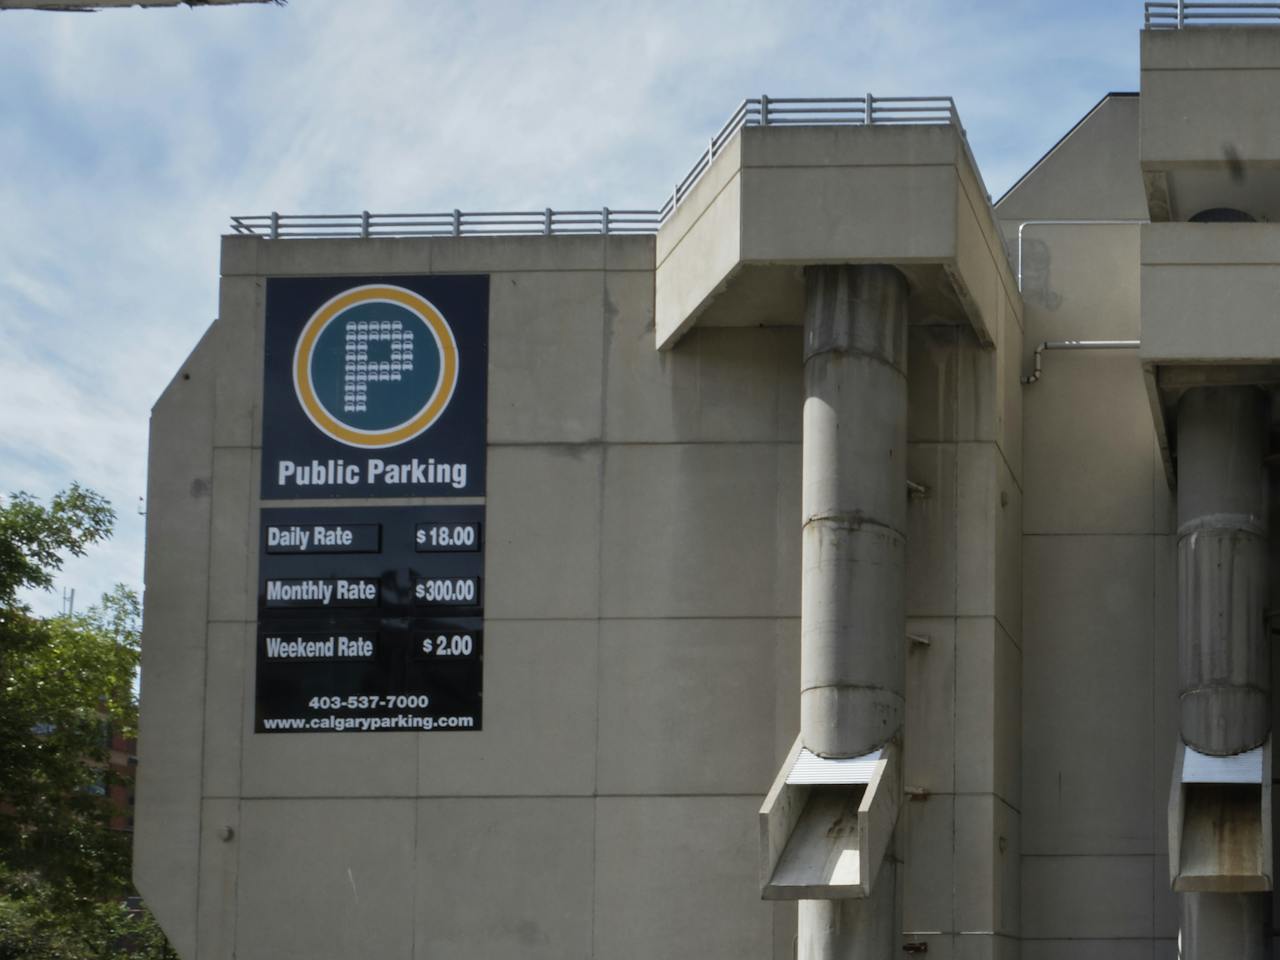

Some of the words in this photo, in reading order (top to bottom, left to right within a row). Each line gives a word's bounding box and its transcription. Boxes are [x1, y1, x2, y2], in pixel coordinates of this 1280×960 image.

[278, 460, 360, 486] Public
[367, 458, 467, 489] Parking
[267, 526, 310, 550] Daily
[313, 526, 353, 546] Rate
[266, 580, 332, 605] Monthly
[336, 580, 376, 600] Rate
[415, 579, 475, 601] $300.00
[266, 637, 335, 658] Weekend
[338, 636, 374, 657] Rate
[308, 695, 429, 709] 403-537-7000
[263, 715, 474, 731] www.calgaryparking.com
